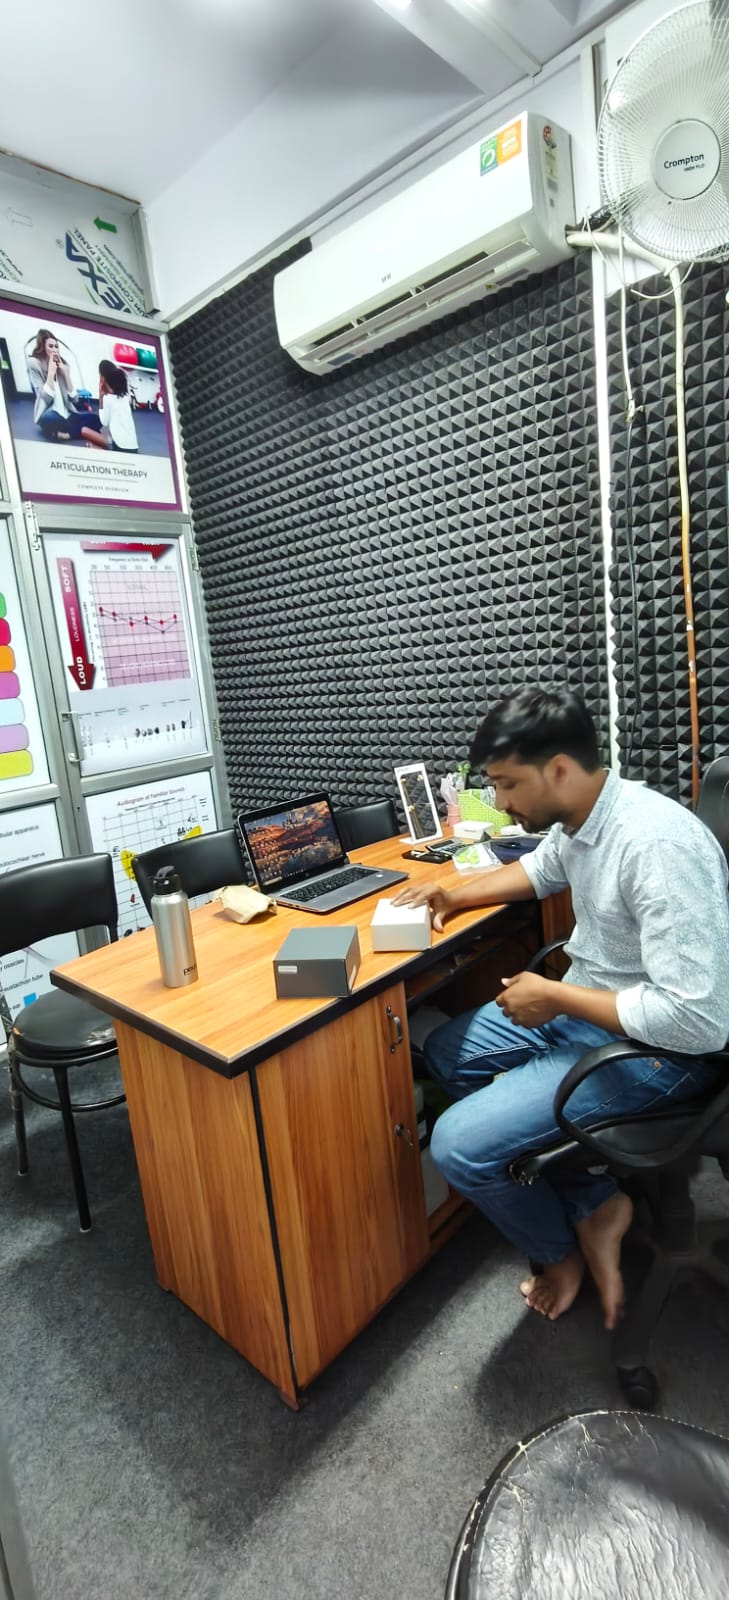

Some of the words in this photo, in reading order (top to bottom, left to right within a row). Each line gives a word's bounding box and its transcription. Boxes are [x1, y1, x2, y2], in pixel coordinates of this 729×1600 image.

[663, 153, 705, 169] Crompton
[73, 228, 97, 256] PANEL
[95, 254, 134, 303] COMPOSITE
[50, 461, 111, 475] ARTICULATION
[112, 467, 148, 479] THERAPY
[61, 565, 72, 593] SOFT
[69, 607, 80, 642] LOUDNESS
[76, 656, 87, 685] LOUD
[32, 974, 44, 982] tube
